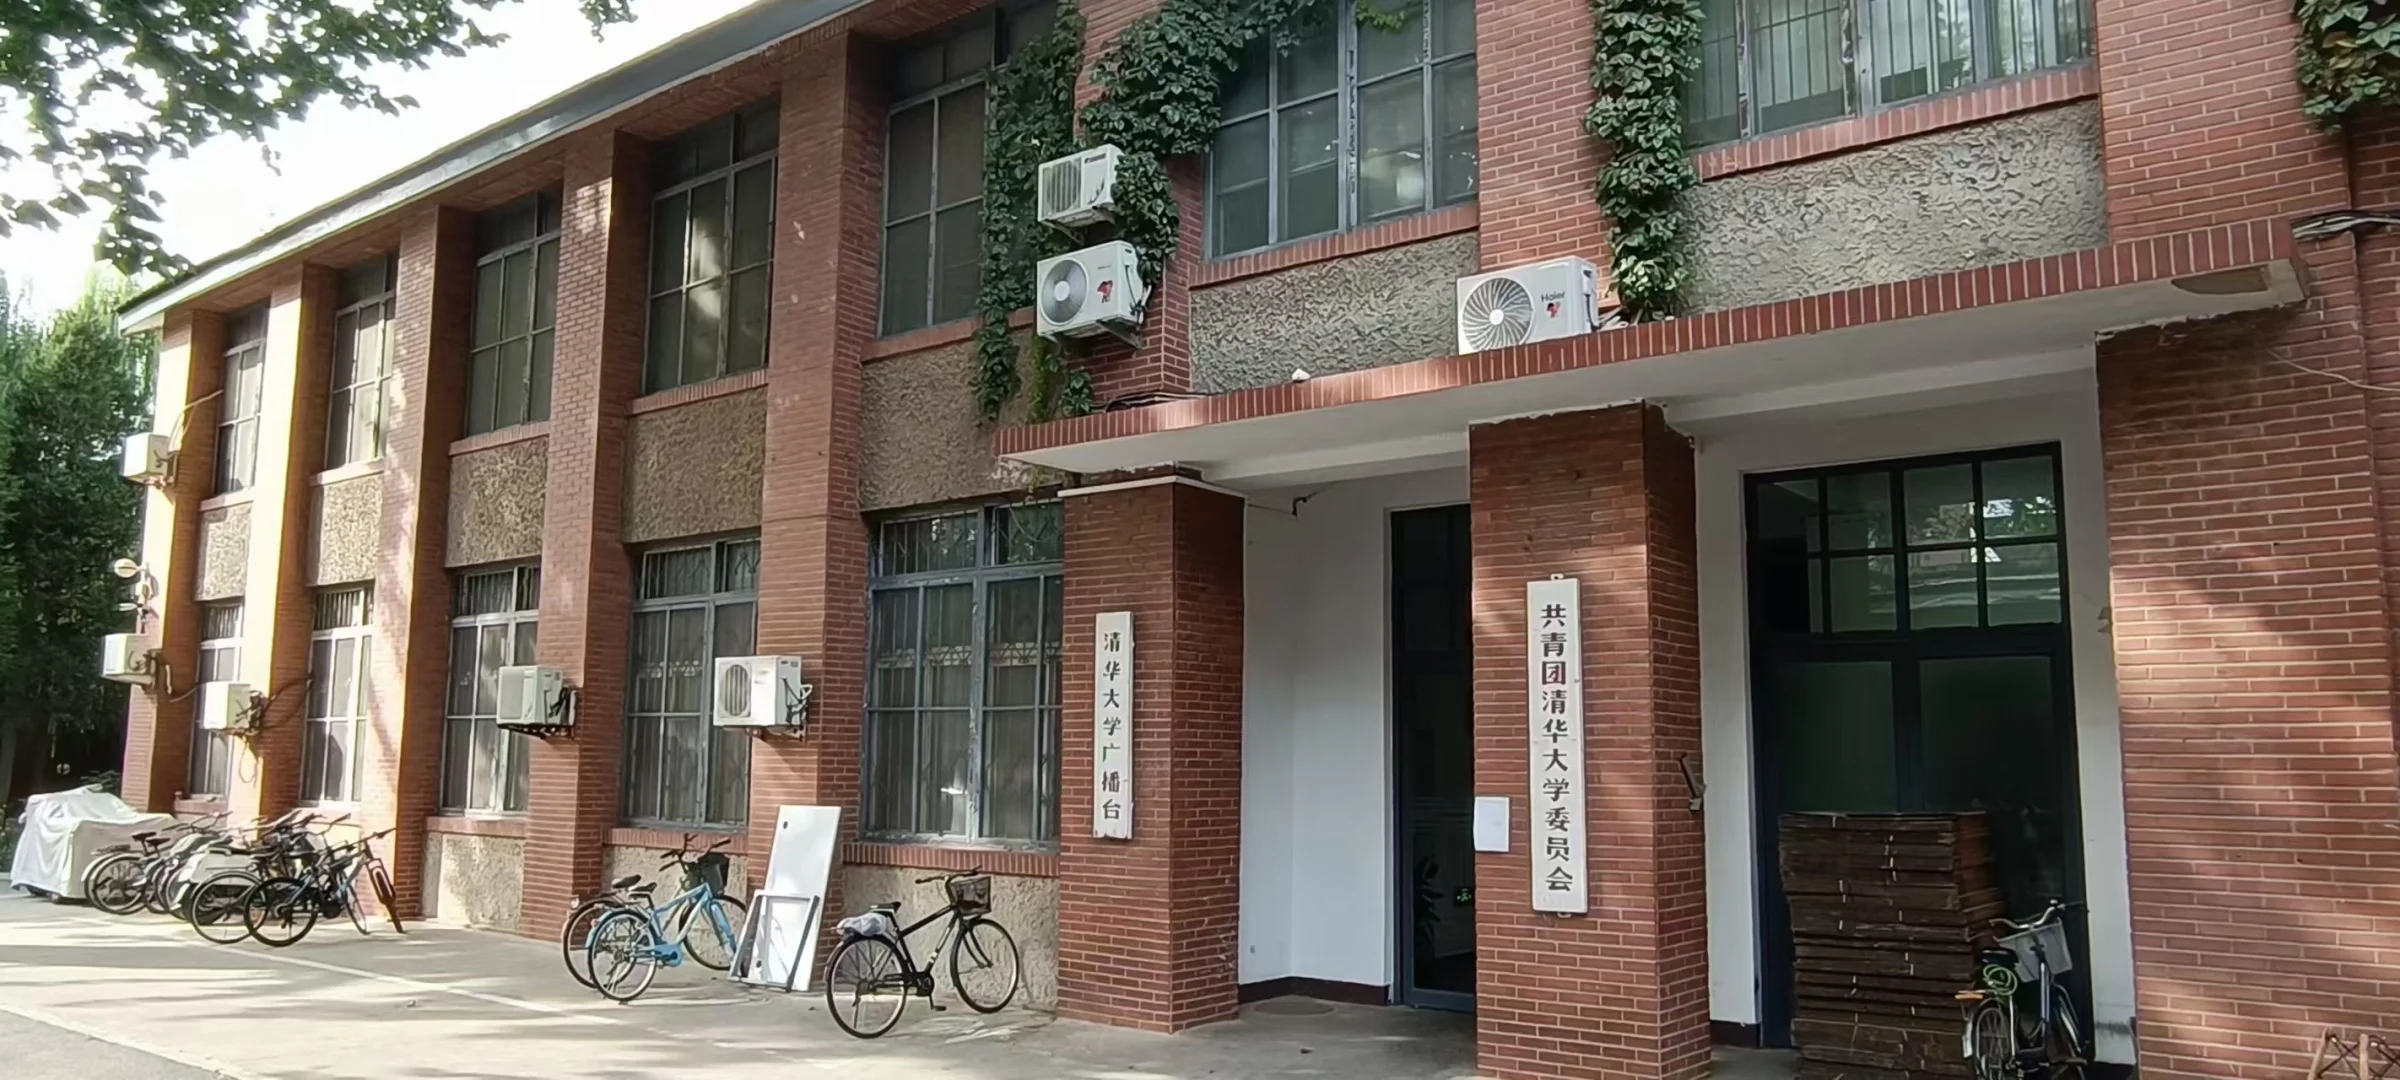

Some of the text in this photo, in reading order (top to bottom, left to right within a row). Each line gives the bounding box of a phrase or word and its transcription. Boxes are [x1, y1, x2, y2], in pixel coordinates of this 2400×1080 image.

[1541, 291, 1566, 303] Haier
[1101, 632, 1121, 820] 清华大学广播台
[1540, 603, 1574, 893] 共青团清华大学委员会
